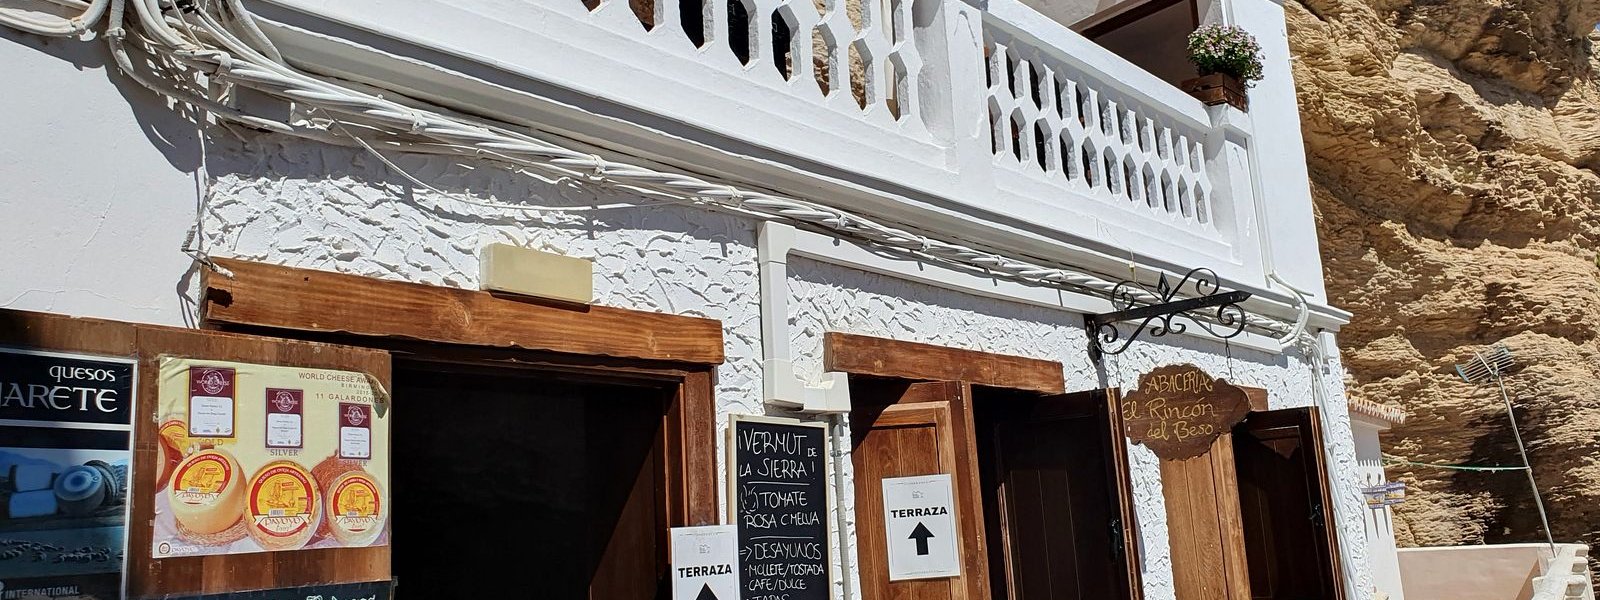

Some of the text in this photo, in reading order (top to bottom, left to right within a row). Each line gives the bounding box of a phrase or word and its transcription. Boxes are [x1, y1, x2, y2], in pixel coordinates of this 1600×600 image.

[49, 365, 116, 383] quesos
[298, 372, 325, 381] WORLD
[326, 374, 355, 383] CHEESE
[341, 382, 370, 390] BIRMING
[0, 382, 118, 413] ARETE
[316, 392, 324, 400] 11
[1121, 396, 1219, 421] El Rincón
[1147, 420, 1214, 442] del Beso
[270, 448, 299, 457] SILVER
[807, 447, 818, 457] DE
[739, 462, 752, 478] LA
[757, 457, 808, 479] SIERRA
[759, 491, 808, 509] TOMATE
[890, 506, 948, 519] TERRAZA
[743, 513, 778, 529] ROSA
[754, 542, 822, 560] DESAYUNOS
[677, 563, 733, 579] TERRAZA
[5, 585, 80, 599] INTERNATIONAL
